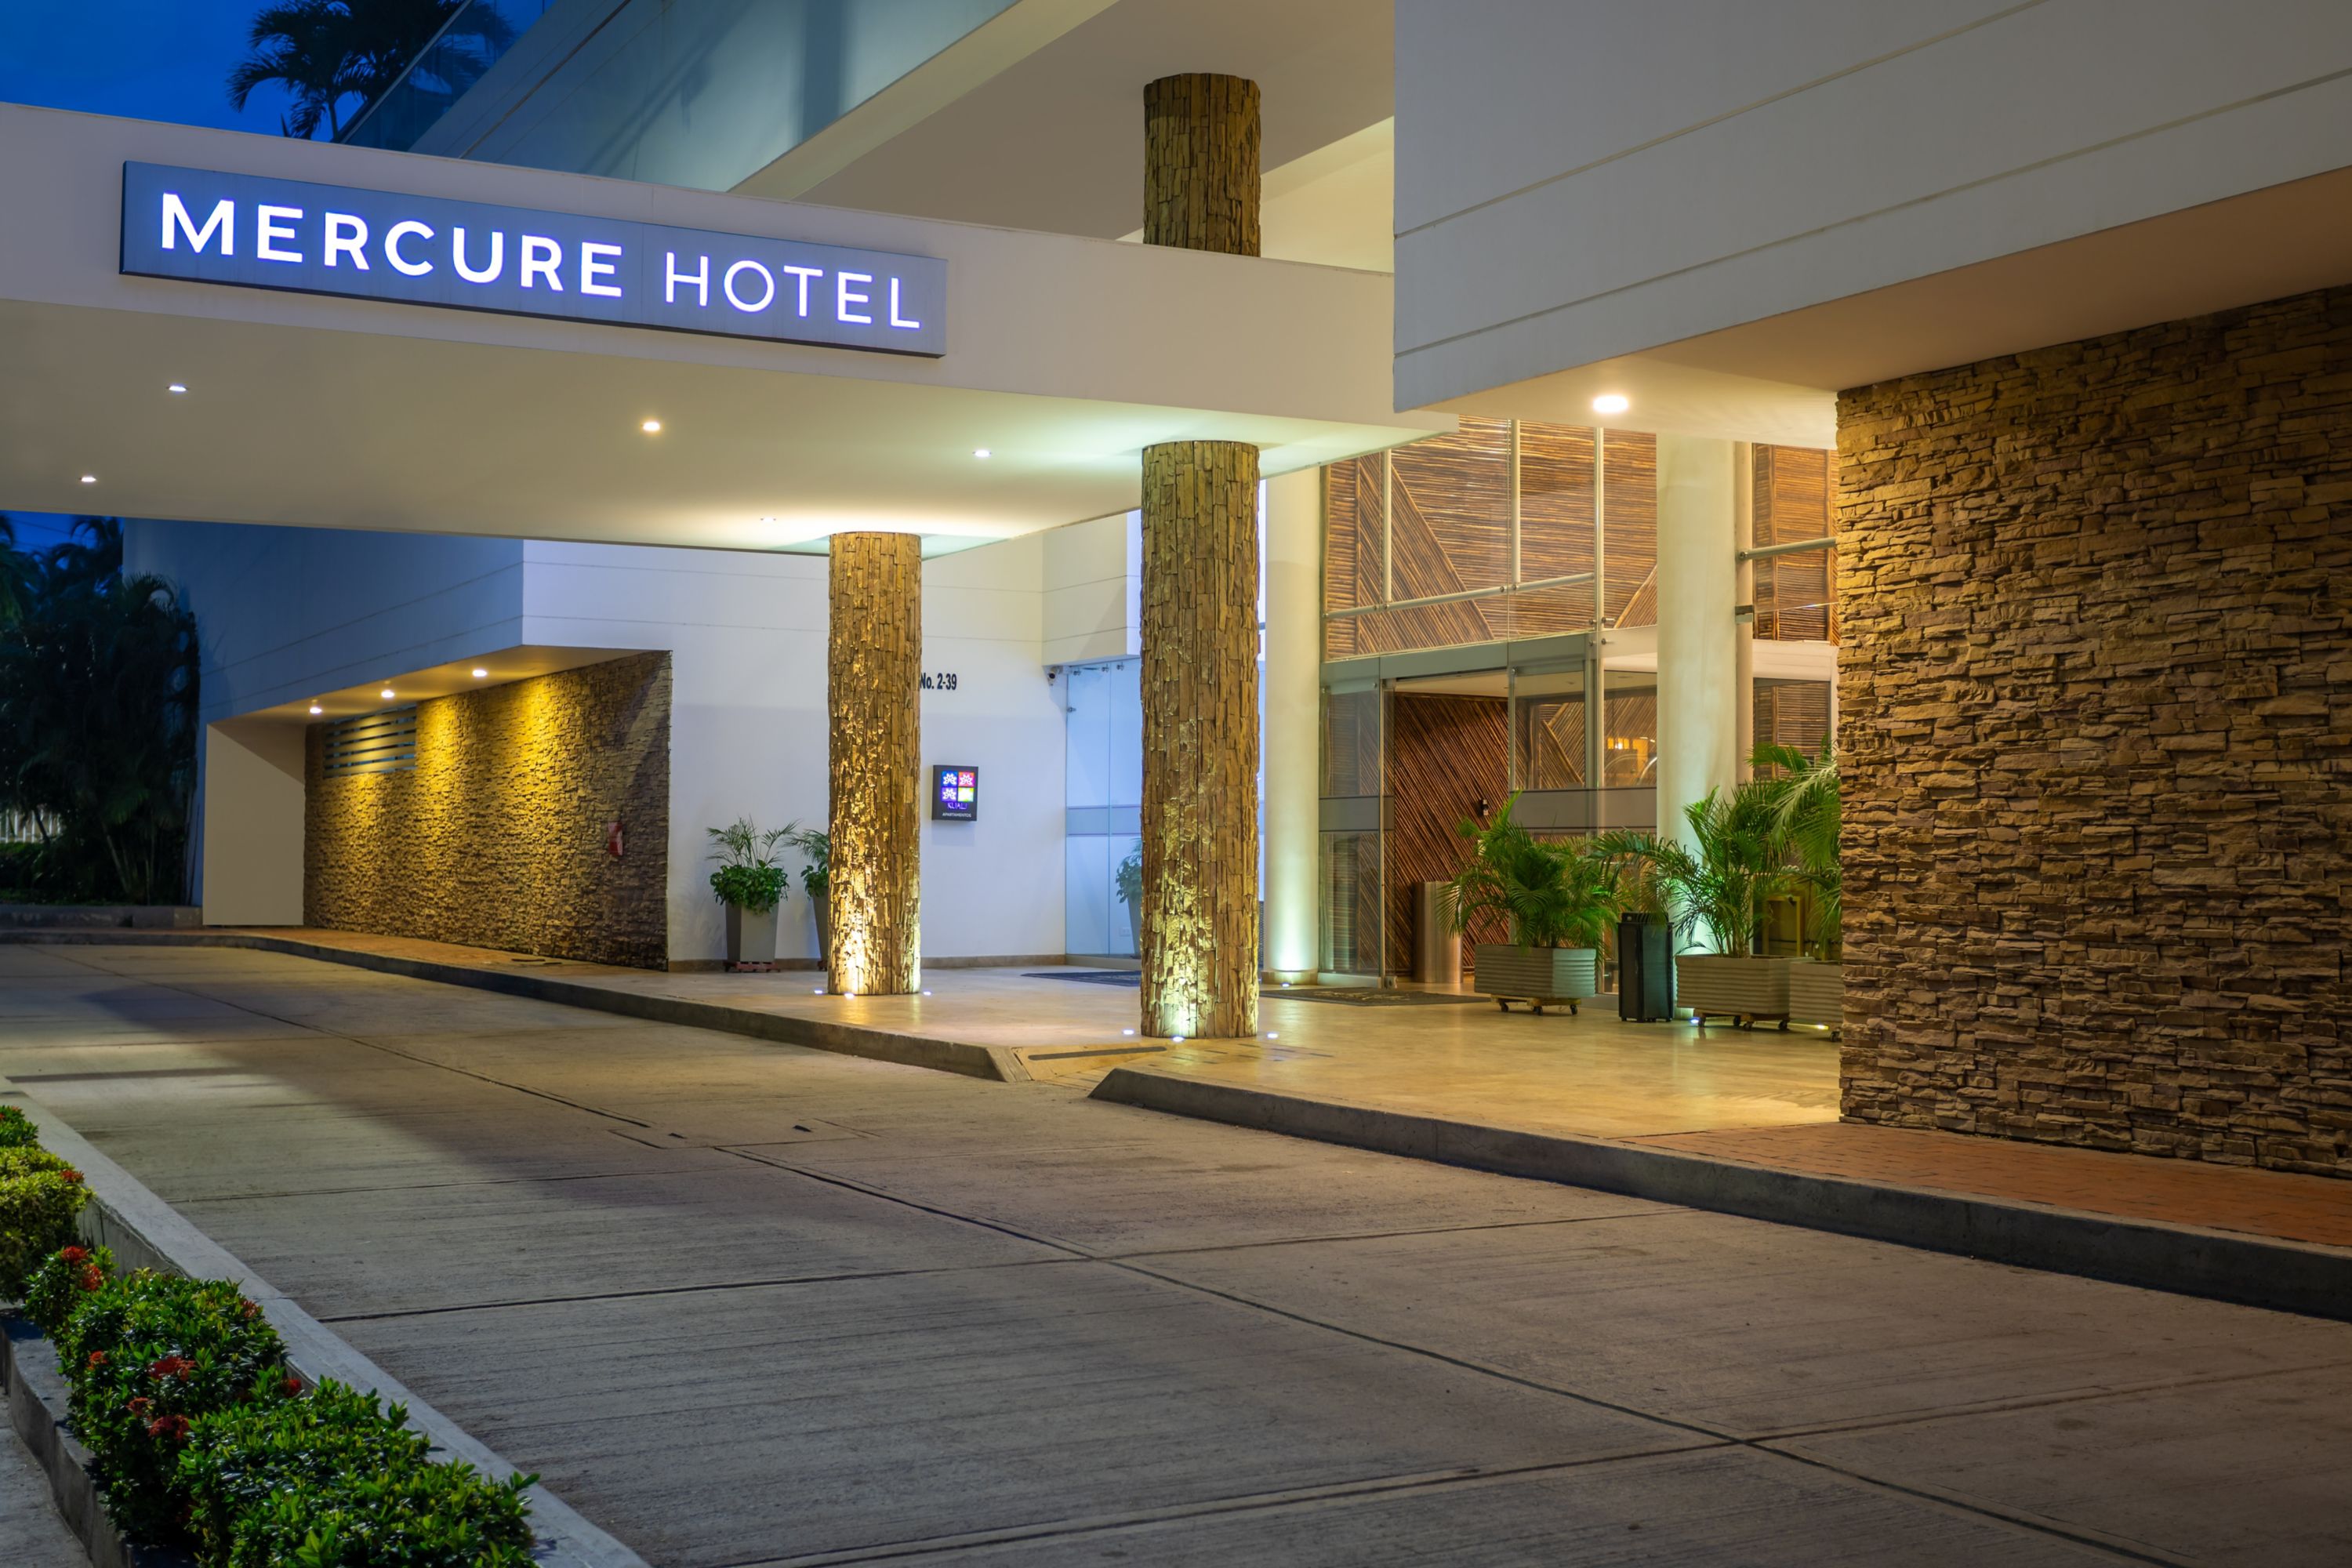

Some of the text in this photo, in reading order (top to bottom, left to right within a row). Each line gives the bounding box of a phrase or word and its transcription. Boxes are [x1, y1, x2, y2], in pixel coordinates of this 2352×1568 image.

[161, 193, 920, 329] MERCURE HOTEL
[920, 673, 957, 690] No. 2-39
